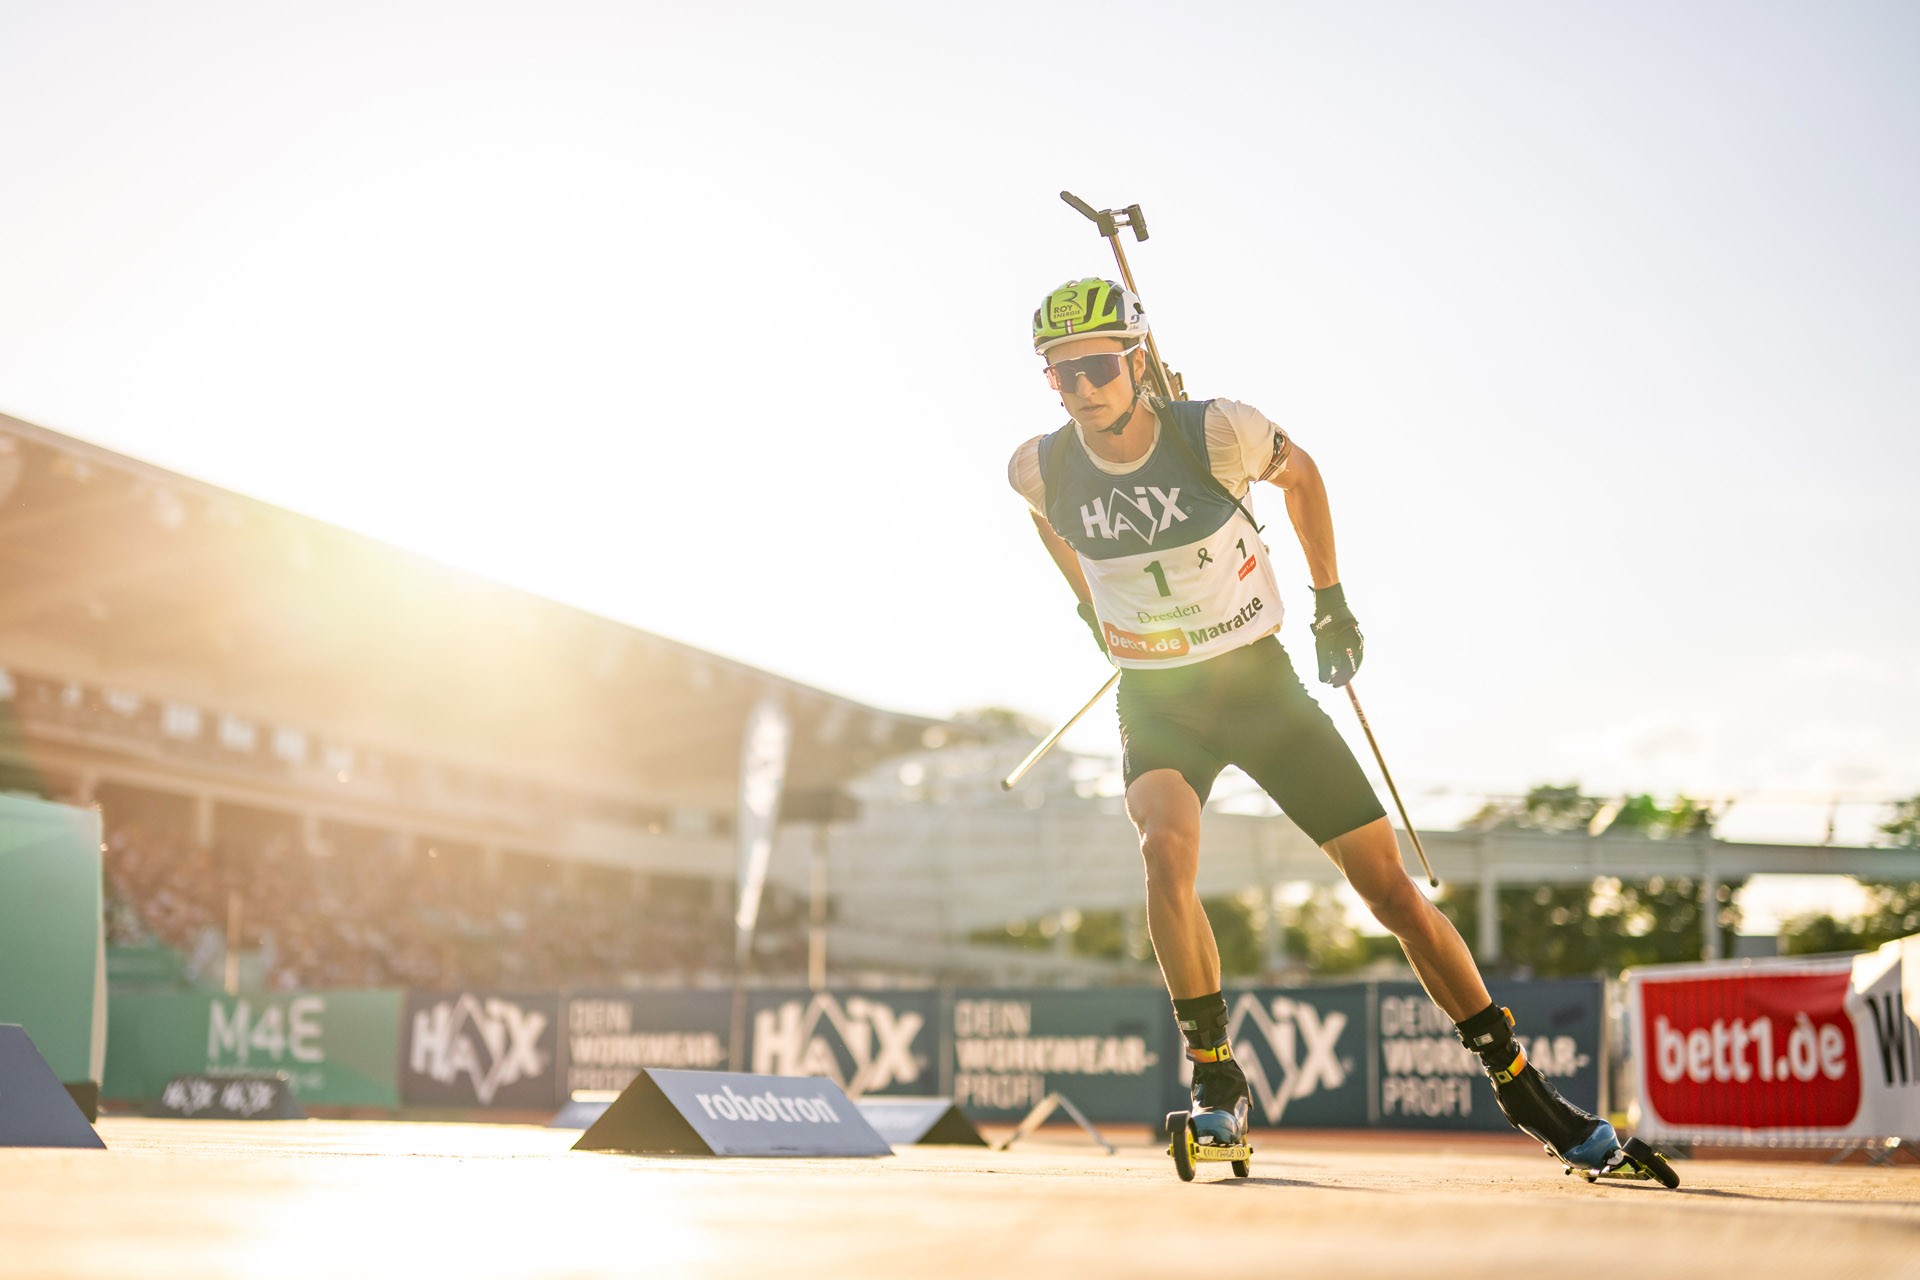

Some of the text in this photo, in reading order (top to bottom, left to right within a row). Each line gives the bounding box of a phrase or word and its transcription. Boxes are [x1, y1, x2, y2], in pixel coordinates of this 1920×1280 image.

[1053, 304, 1073, 314] ROY
[1053, 310, 1081, 319] ENERGIE
[1236, 537, 1247, 560] 1
[1143, 560, 1172, 598] 1
[1136, 602, 1203, 625] Dresden
[1187, 596, 1264, 647] Matratze
[208, 997, 326, 1064] M4E
[1655, 1012, 1847, 1083] bett1.de
[695, 1085, 841, 1125] robotron
[1382, 1075, 1473, 1117] PROFI
